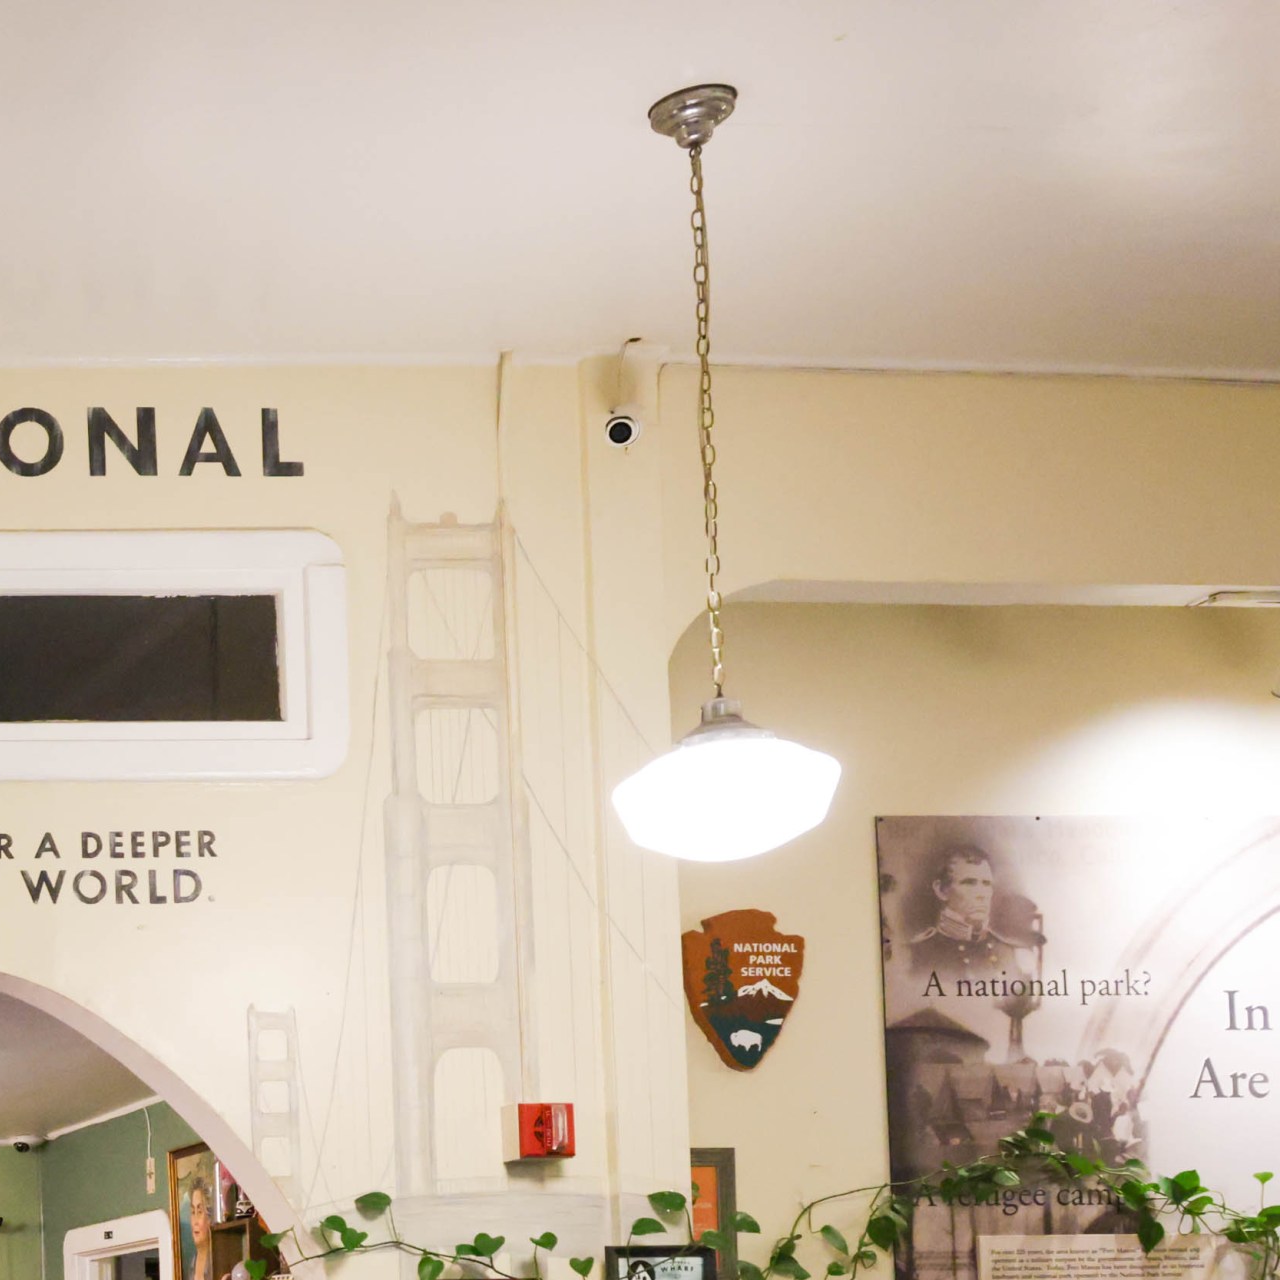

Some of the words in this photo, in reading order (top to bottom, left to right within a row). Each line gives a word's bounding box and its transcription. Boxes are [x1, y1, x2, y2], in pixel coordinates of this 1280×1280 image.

[34, 832, 61, 860] A
[81, 830, 218, 859] DEEPER
[20, 868, 215, 905] WORLD.
[733, 943, 797, 953] NATIONAL
[749, 955, 782, 964] PARK
[741, 967, 792, 977] SERVICE
[922, 970, 946, 998] A
[956, 969, 1068, 998] national
[1080, 969, 1152, 1005] park?
[1223, 989, 1273, 1031] In
[1190, 1057, 1270, 1099] Are
